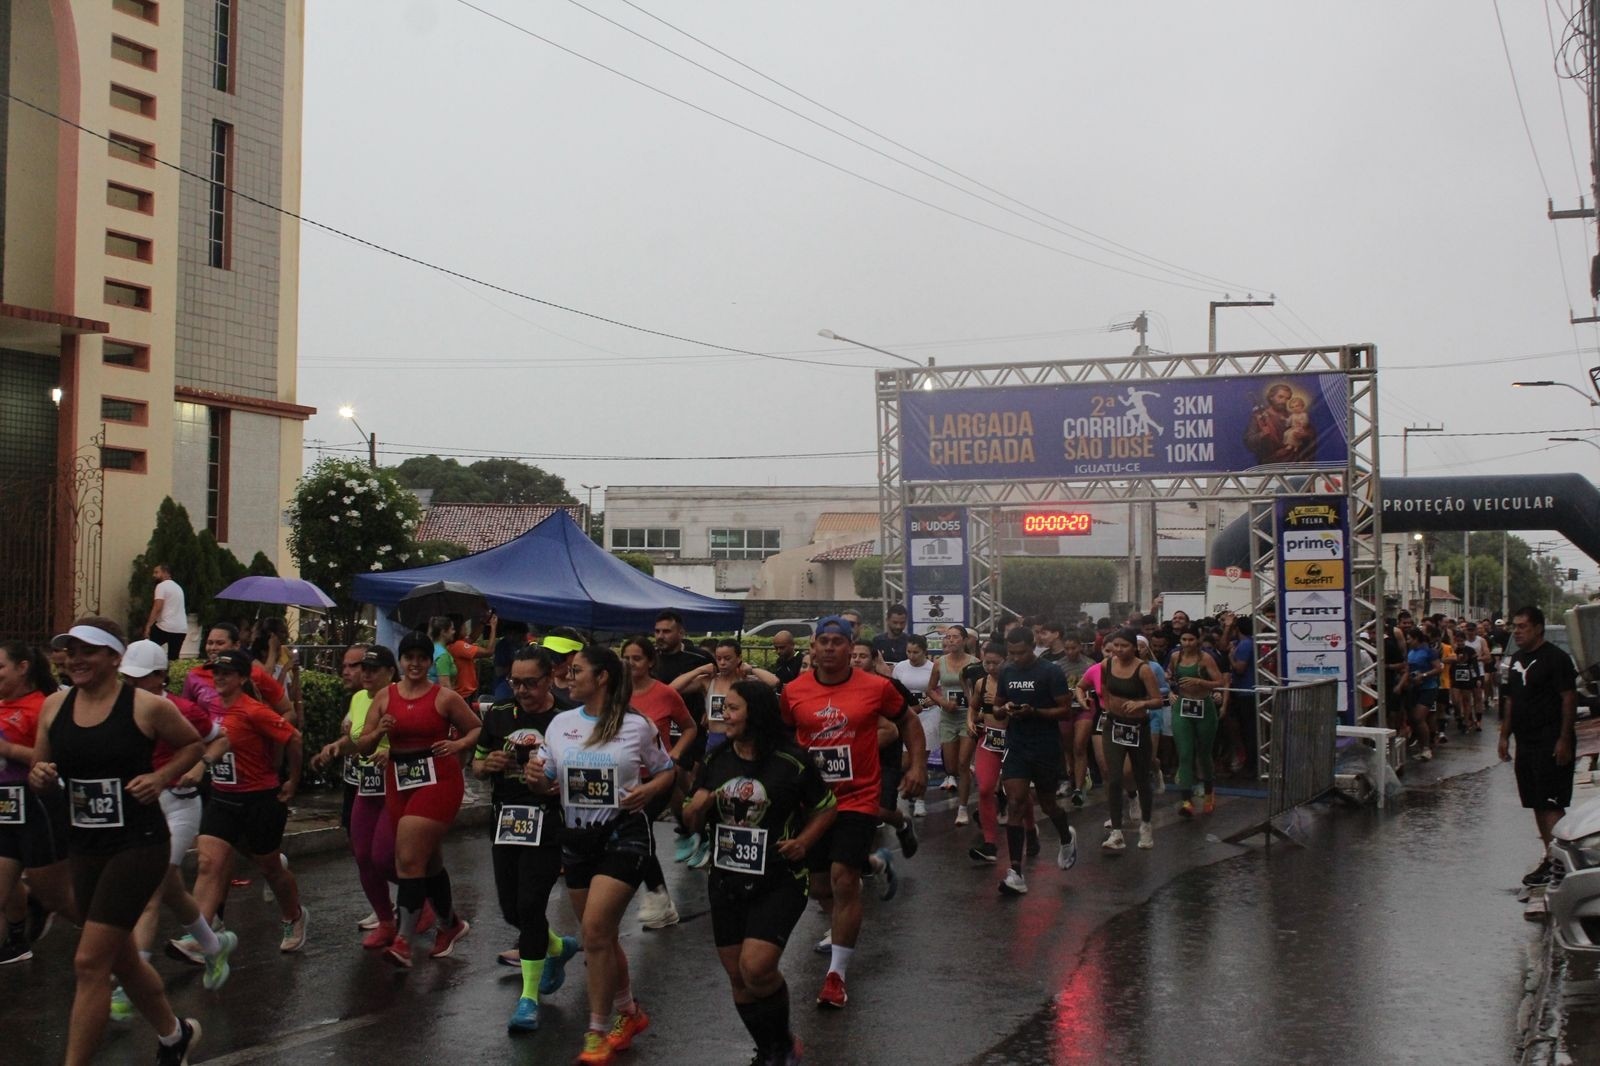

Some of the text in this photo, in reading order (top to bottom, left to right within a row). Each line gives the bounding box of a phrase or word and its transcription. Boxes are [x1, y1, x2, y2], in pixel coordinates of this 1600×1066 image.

[1174, 395, 1213, 416] 3KM
[929, 410, 1034, 439] LARGADA
[1063, 416, 1150, 439] CORRIDA
[1174, 419, 1213, 439] 5KM
[930, 438, 1036, 465] CHEGADA
[1108, 432, 1155, 459] JOSÉ
[1165, 443, 1215, 463] 10KM
[1074, 463, 1141, 474] IGUATU-CE
[1383, 495, 1554, 515] PROTEÇÃO VEICULAR
[1025, 514, 1089, 531] 00:00:20
[1287, 536, 1334, 552] prime
[1294, 576, 1334, 585] SuperFIT
[1288, 607, 1342, 616] FORT
[1009, 680, 1035, 689] STARK
[409, 767, 425, 778] 421
[827, 758, 846, 772] 300
[364, 776, 381, 787] 230
[588, 782, 610, 796] 532
[88, 797, 113, 814] 182
[514, 820, 534, 834] 533
[736, 844, 758, 861] 338
